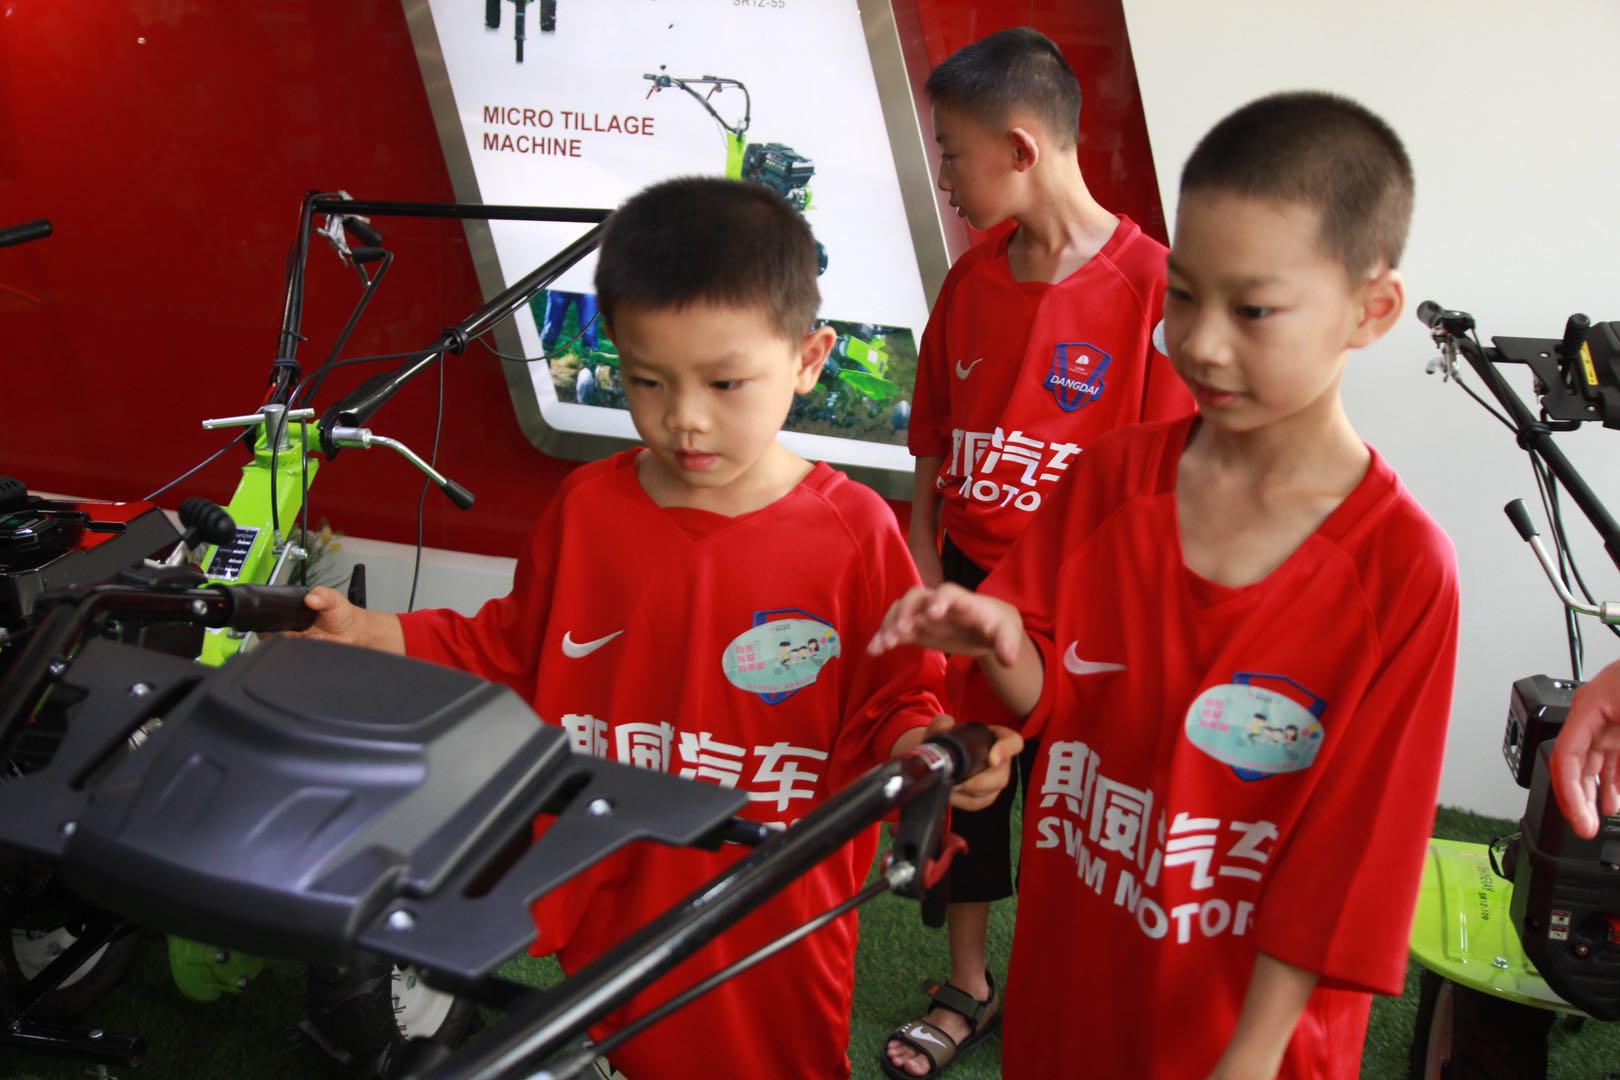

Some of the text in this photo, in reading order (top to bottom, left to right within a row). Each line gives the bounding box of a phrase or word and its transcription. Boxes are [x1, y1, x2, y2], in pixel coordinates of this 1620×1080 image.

[483, 105, 655, 136] MICRO TILLAGE
[483, 132, 582, 158] MACHINE
[1049, 374, 1099, 395] DANGDAI
